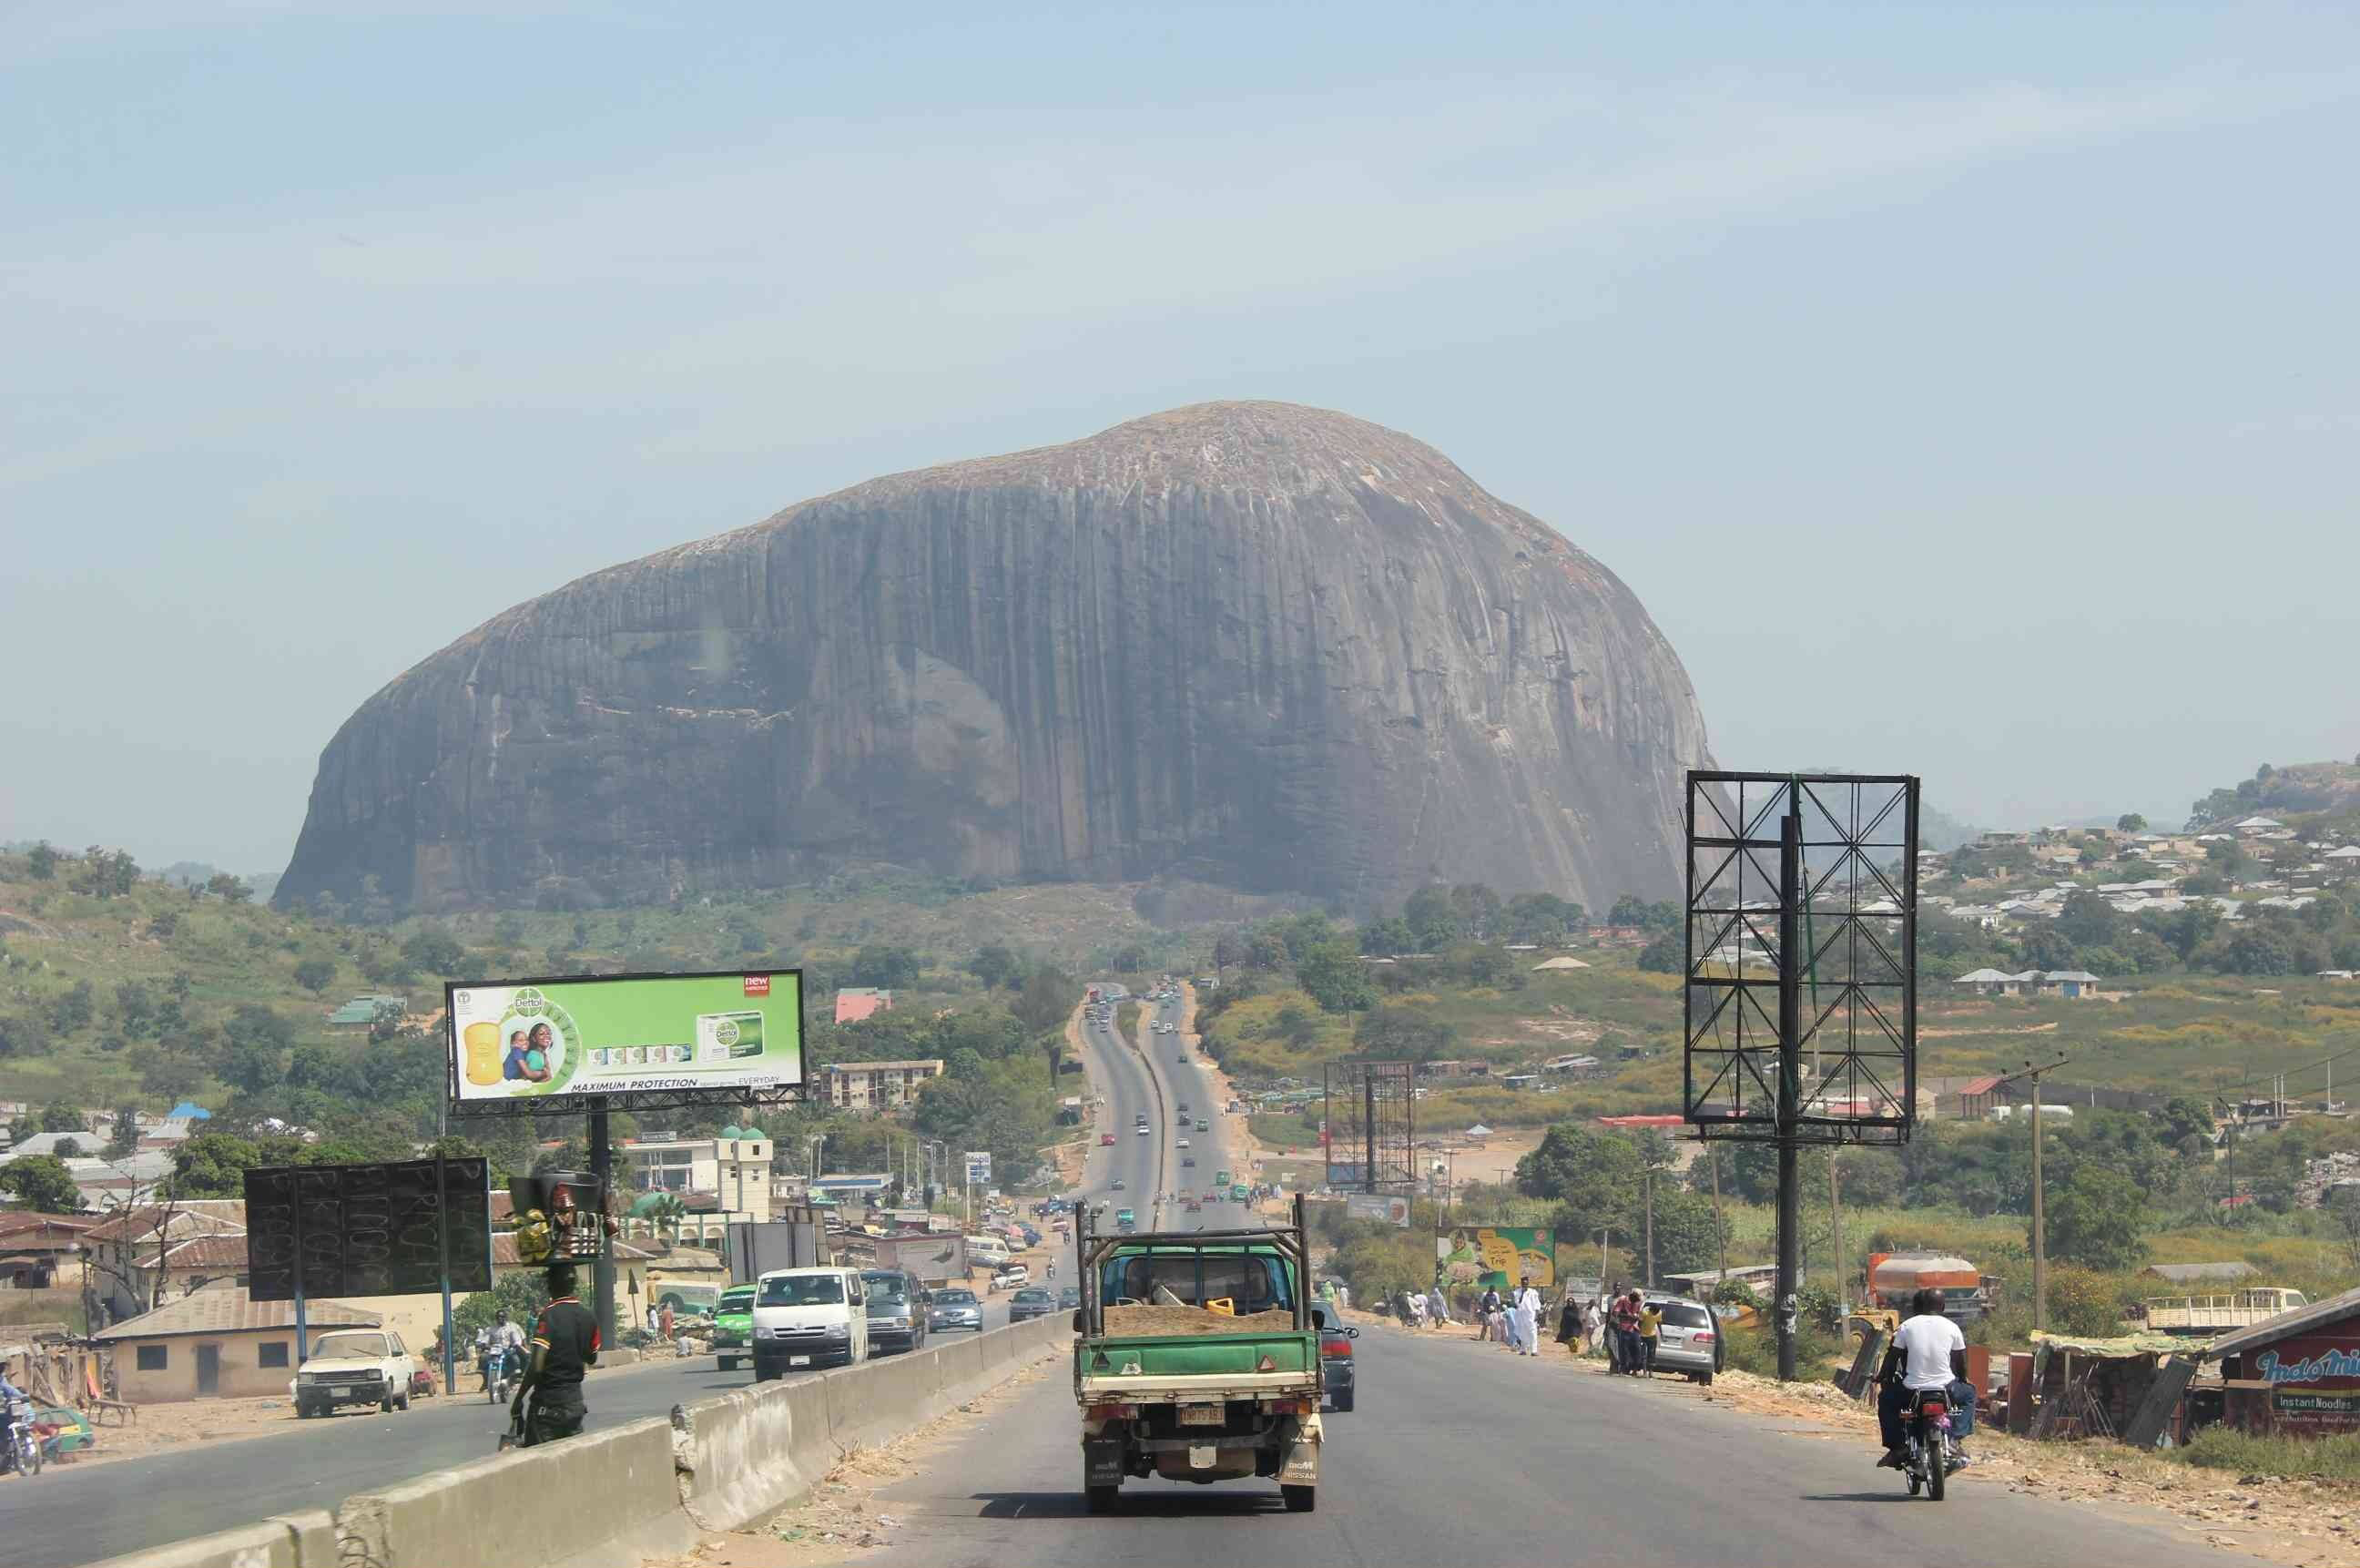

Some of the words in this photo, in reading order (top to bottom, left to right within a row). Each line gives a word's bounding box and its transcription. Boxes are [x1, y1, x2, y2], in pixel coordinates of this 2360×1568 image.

[745, 977, 768, 985] new
[515, 997, 542, 1007] Dettol
[571, 1082, 626, 1092] MAXIMUM
[630, 1078, 698, 1089] PROTECTION
[738, 1075, 780, 1085] EVERYDAY
[2280, 1396, 2314, 1407] Instant
[2315, 1397, 2353, 1410] Noodles
